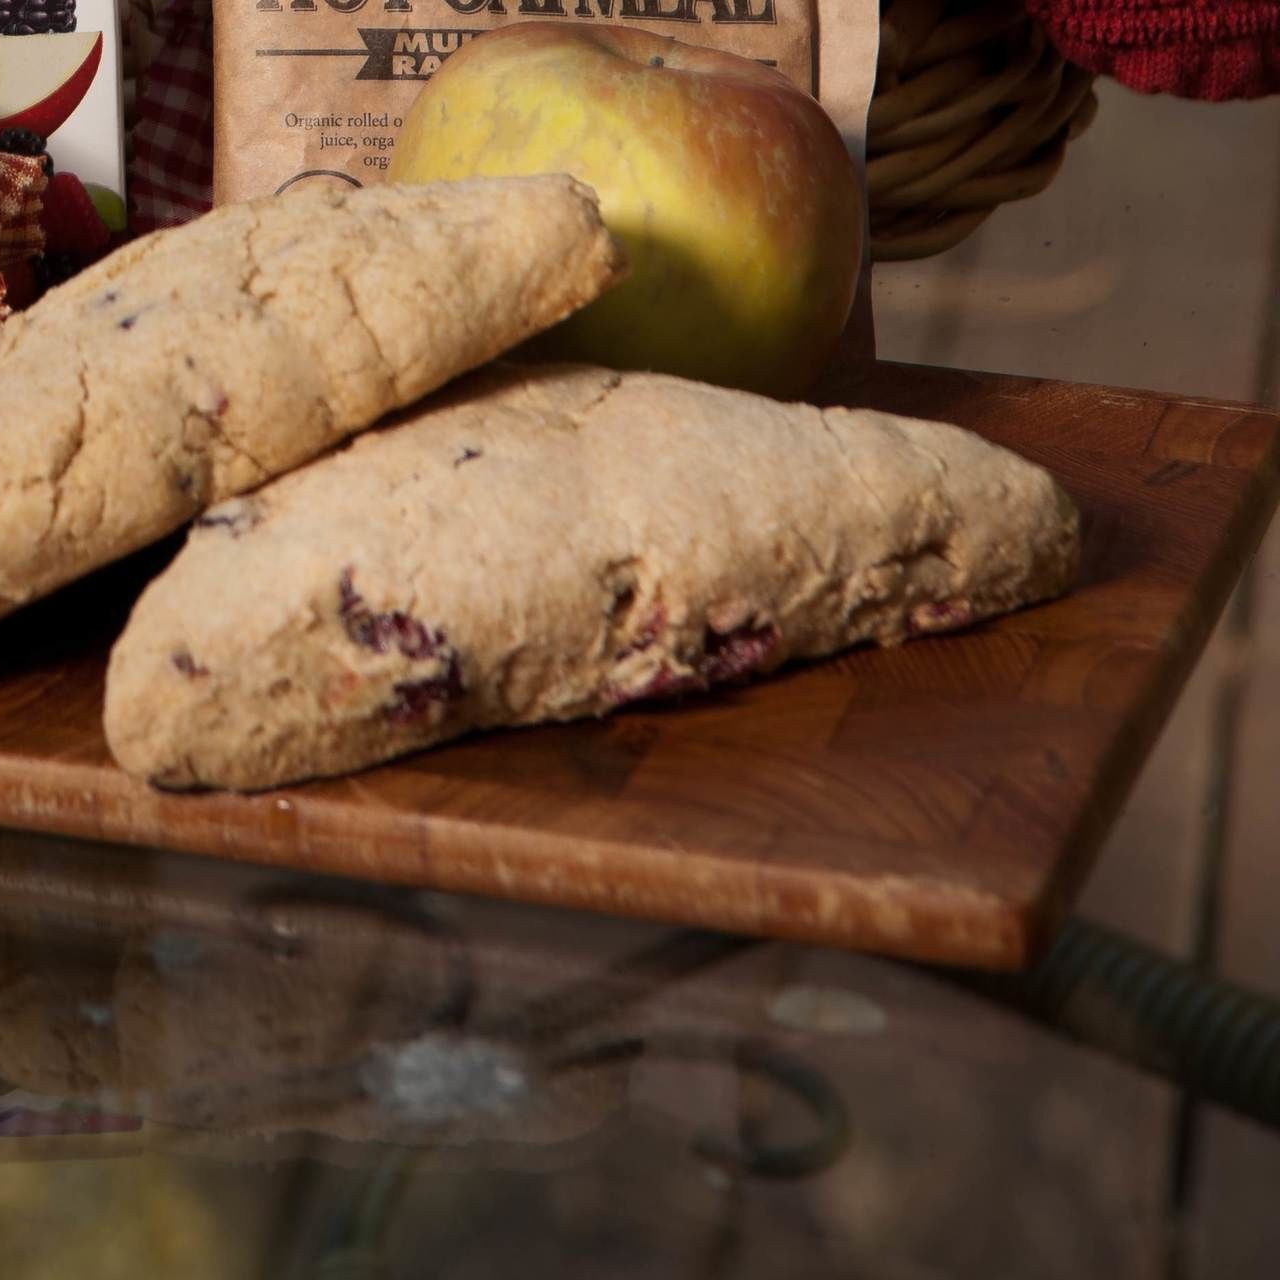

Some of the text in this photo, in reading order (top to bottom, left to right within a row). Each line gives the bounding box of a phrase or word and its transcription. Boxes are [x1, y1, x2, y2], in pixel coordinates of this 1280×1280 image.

[392, 55, 443, 76] RA
[285, 112, 343, 131] Organic
[347, 112, 389, 128] rolled
[319, 132, 395, 150] juice, orga
